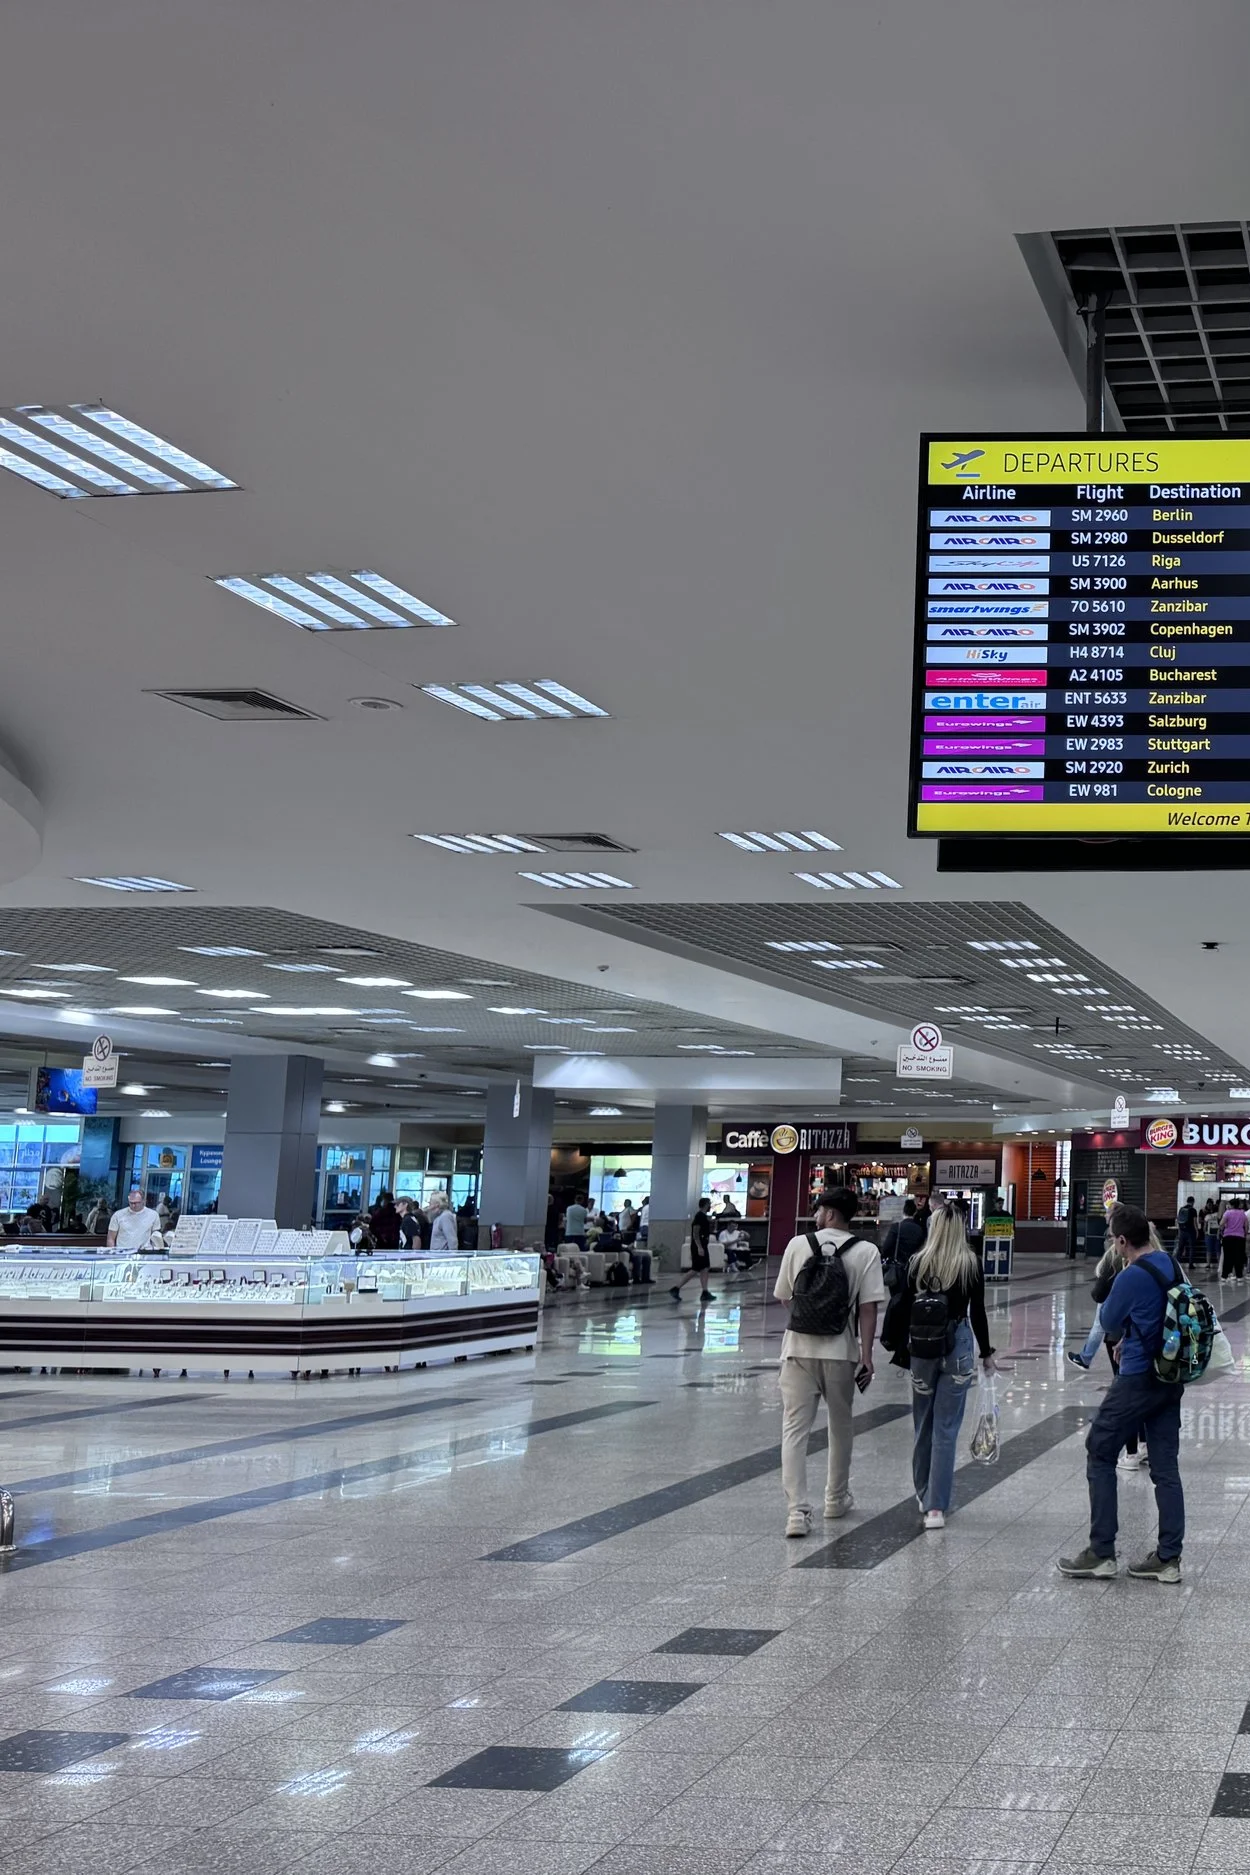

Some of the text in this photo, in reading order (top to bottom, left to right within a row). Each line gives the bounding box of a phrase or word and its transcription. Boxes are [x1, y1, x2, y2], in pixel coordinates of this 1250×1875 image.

[1005, 453, 1158, 472] DEPARTURES
[963, 485, 1016, 499] Airline
[1077, 485, 1123, 502] Flight
[1150, 484, 1240, 498] Destination
[1072, 510, 1128, 521] SM 2960
[1153, 509, 1192, 521] Berlin
[1071, 532, 1127, 544] SM 2980
[1153, 531, 1224, 543] Dusseldorf
[1073, 555, 1125, 567] U5 7126
[1153, 555, 1180, 569] Riga
[1070, 578, 1126, 589] SM 3900
[1152, 577, 1198, 589] Aarhus
[929, 604, 1030, 614] smartwings
[1071, 601, 1125, 612] 7O 5610
[1151, 600, 1208, 612] Zanzibar
[1069, 623, 1125, 635] SM 3902
[1151, 623, 1232, 637] Copenhagen
[966, 649, 1008, 662] HiSky
[1071, 646, 1124, 658] H4 8714
[1150, 646, 1175, 660] Cluj
[1069, 669, 1123, 681] A2 4105
[1150, 669, 1217, 681] Bucharest
[932, 694, 1025, 709] enter
[1065, 692, 1127, 704] ENT 5633
[1149, 692, 1206, 704] Zanzibar
[1067, 715, 1123, 727] EW 4393
[1149, 715, 1206, 730] Salzburg
[1067, 738, 1123, 750] EW 2983
[1148, 738, 1210, 753] Stuttgart
[1066, 761, 1123, 773] SM 2920
[1148, 761, 1189, 773] Zurich
[1070, 784, 1116, 796] EW 981
[1148, 784, 1202, 799] Cologne
[1169, 812, 1240, 825] Welcome
[1150, 1125, 1173, 1135] BURGER
[1150, 1130, 1173, 1142] KING
[726, 1129, 850, 1149] Caffè RITAZZA
[949, 1165, 978, 1178] RITAZZA
